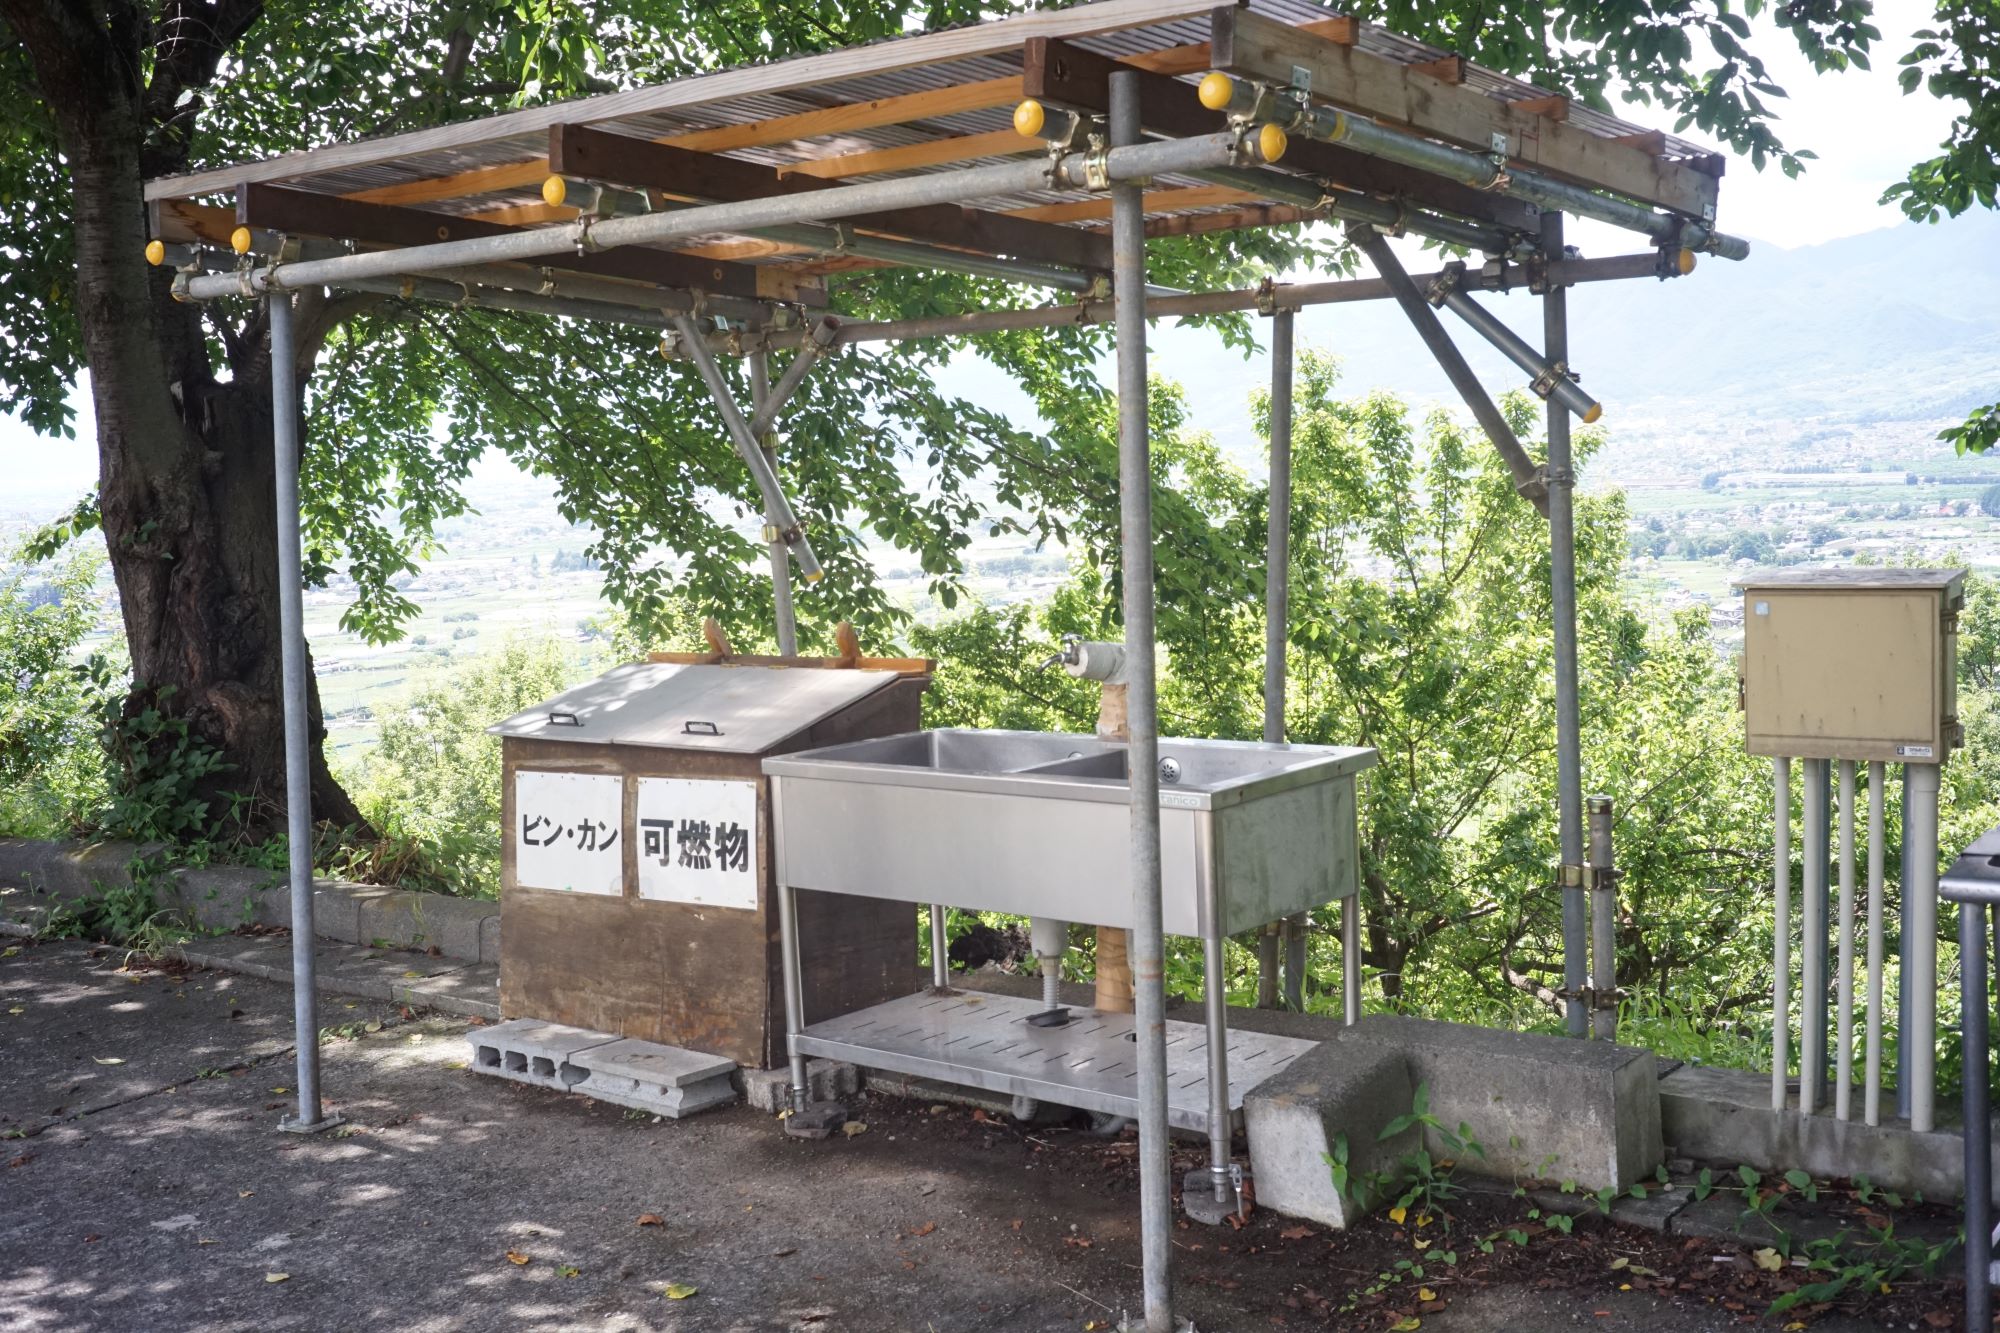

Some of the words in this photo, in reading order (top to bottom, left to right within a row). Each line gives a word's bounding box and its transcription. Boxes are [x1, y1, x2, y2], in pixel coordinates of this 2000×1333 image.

[523, 814, 618, 851] ビン・カン
[640, 818, 749, 873] 可燃物
